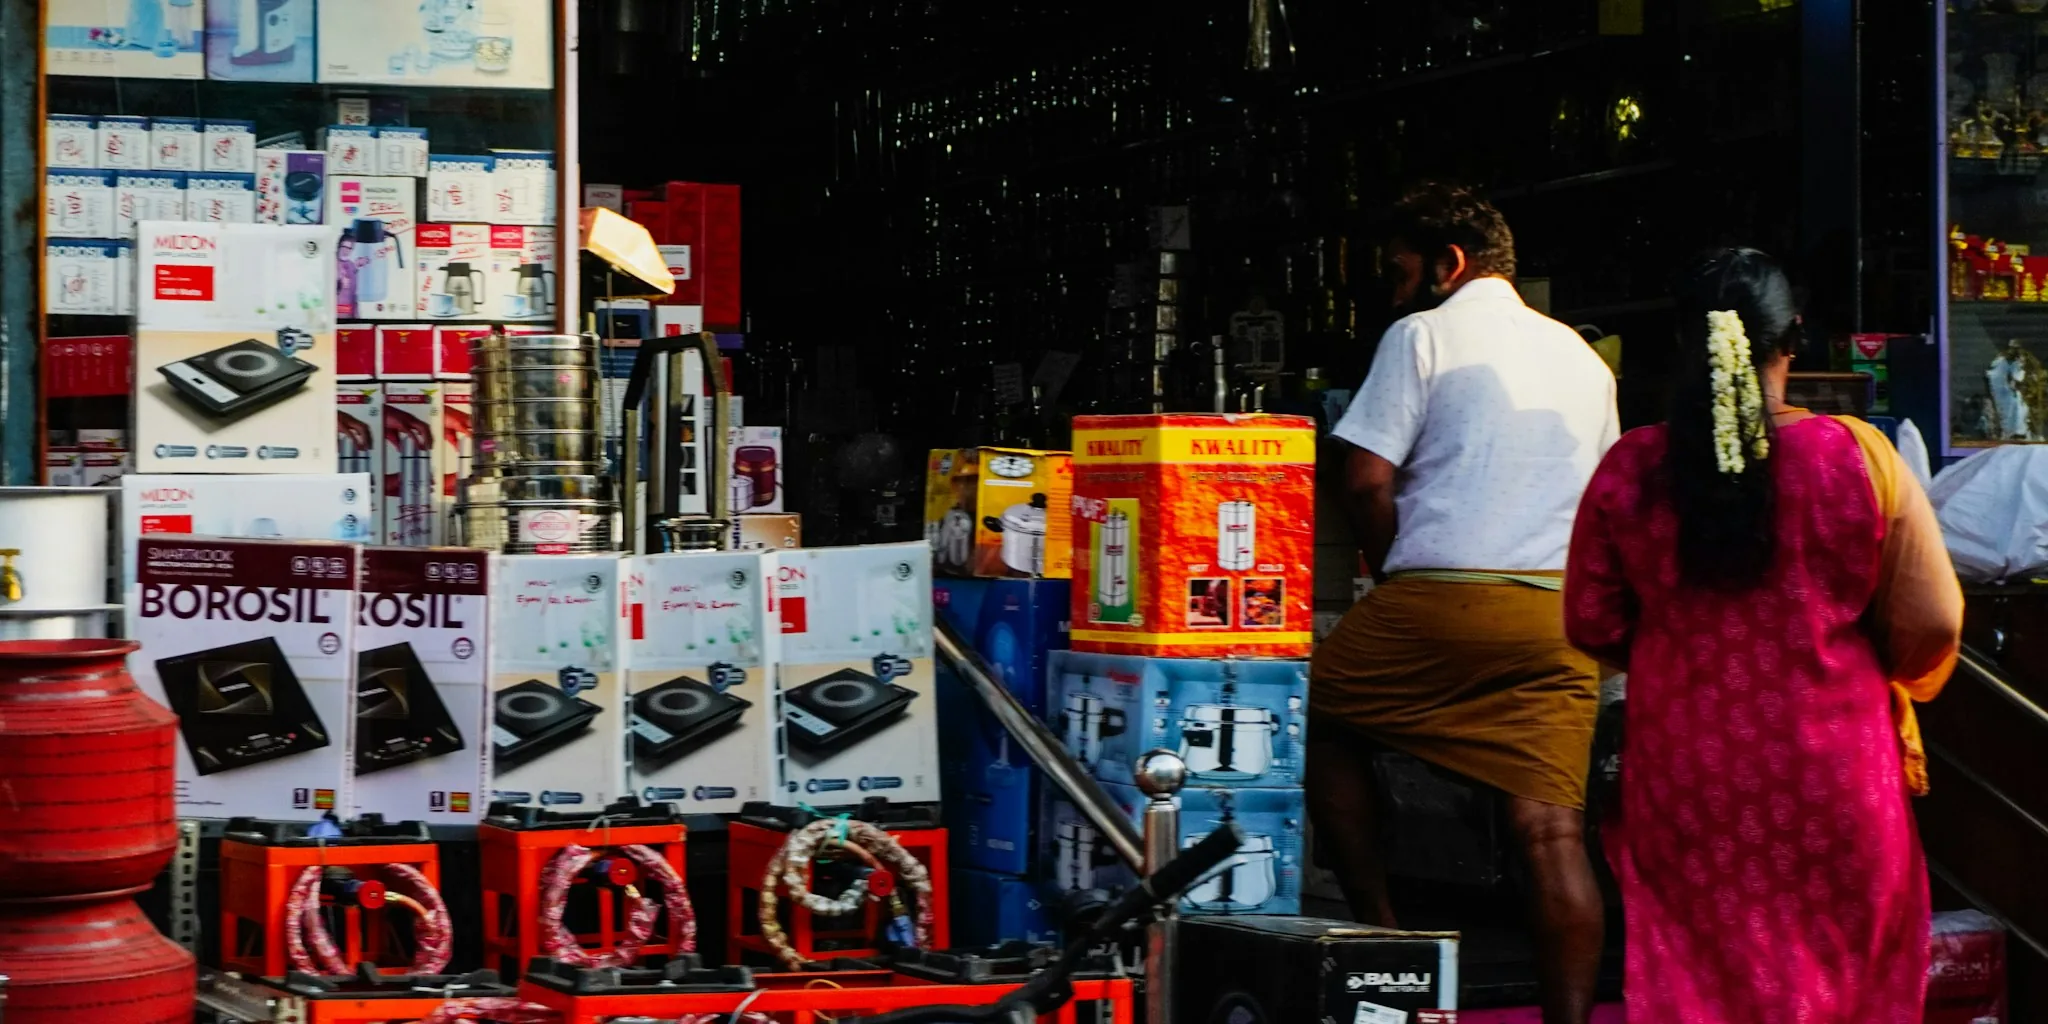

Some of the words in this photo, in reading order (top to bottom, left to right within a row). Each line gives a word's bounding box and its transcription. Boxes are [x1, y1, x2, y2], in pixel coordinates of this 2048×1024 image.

[153, 235, 217, 251] MILTON
[1087, 439, 1143, 456] KWALITY
[1191, 438, 1285, 456] KWALITY
[140, 487, 195, 502] MILTON
[140, 583, 331, 624] BOROSIL
[1363, 972, 1432, 986] BAJAJ
